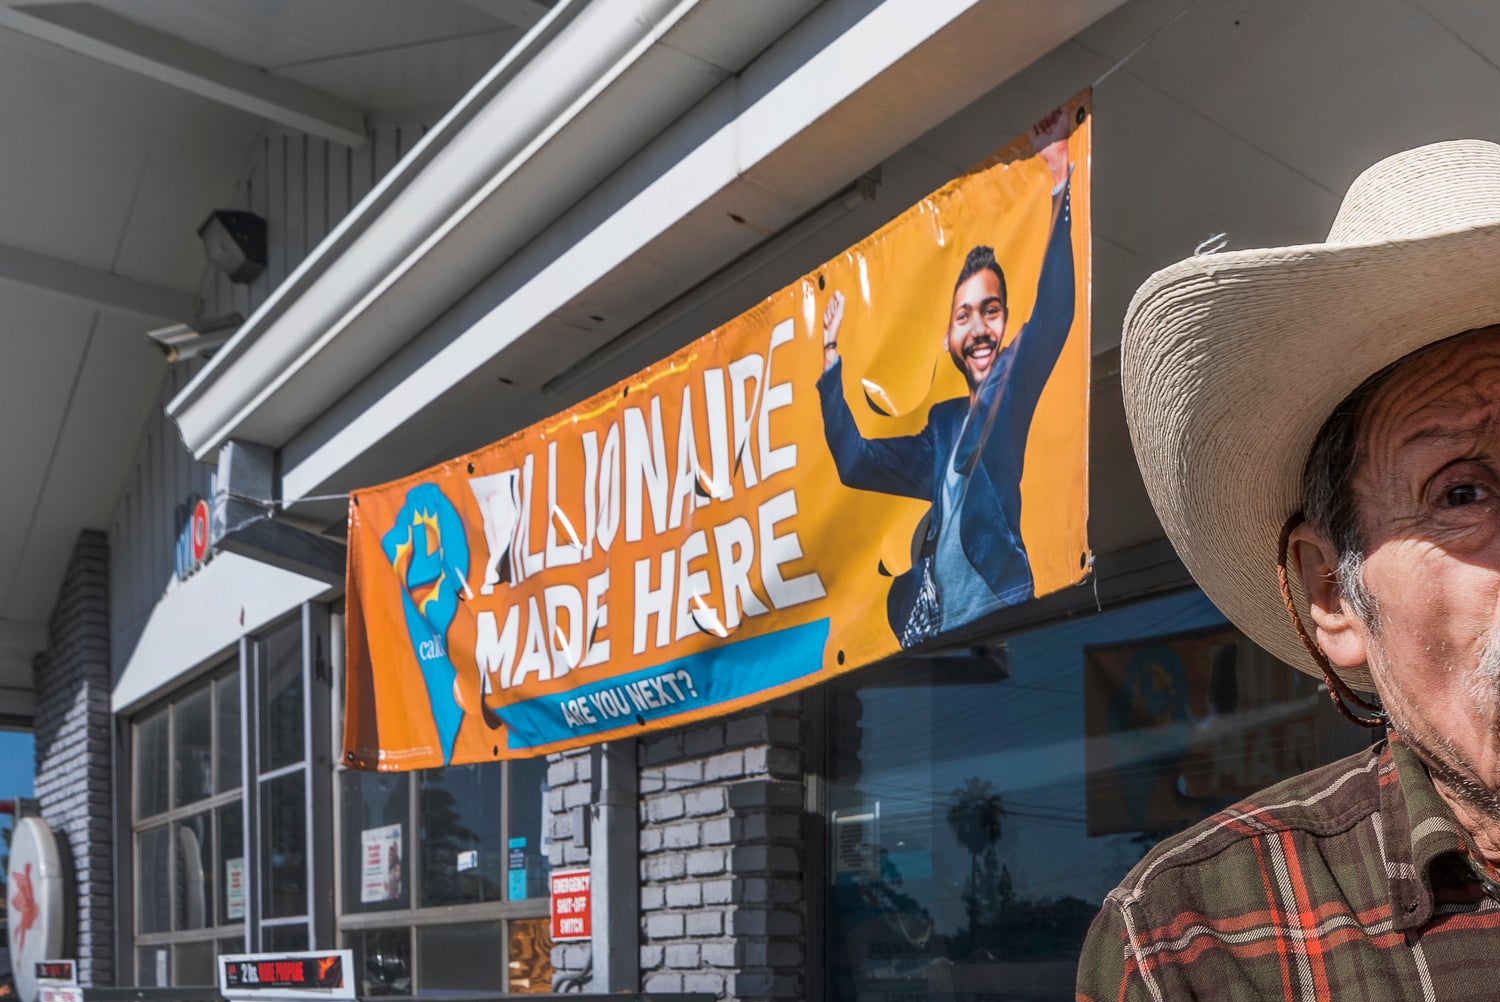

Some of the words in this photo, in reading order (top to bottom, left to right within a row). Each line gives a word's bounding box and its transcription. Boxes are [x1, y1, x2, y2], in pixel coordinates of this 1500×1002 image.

[475, 568, 611, 694] MADE
[633, 489, 827, 655] HERE
[560, 696, 597, 728] ARE
[591, 688, 631, 720] YOU
[632, 670, 698, 714] NEXT?
[553, 875, 590, 895] EMERGENCY
[557, 896, 586, 914] SHUT-OFF
[560, 917, 584, 934] SWITCH
